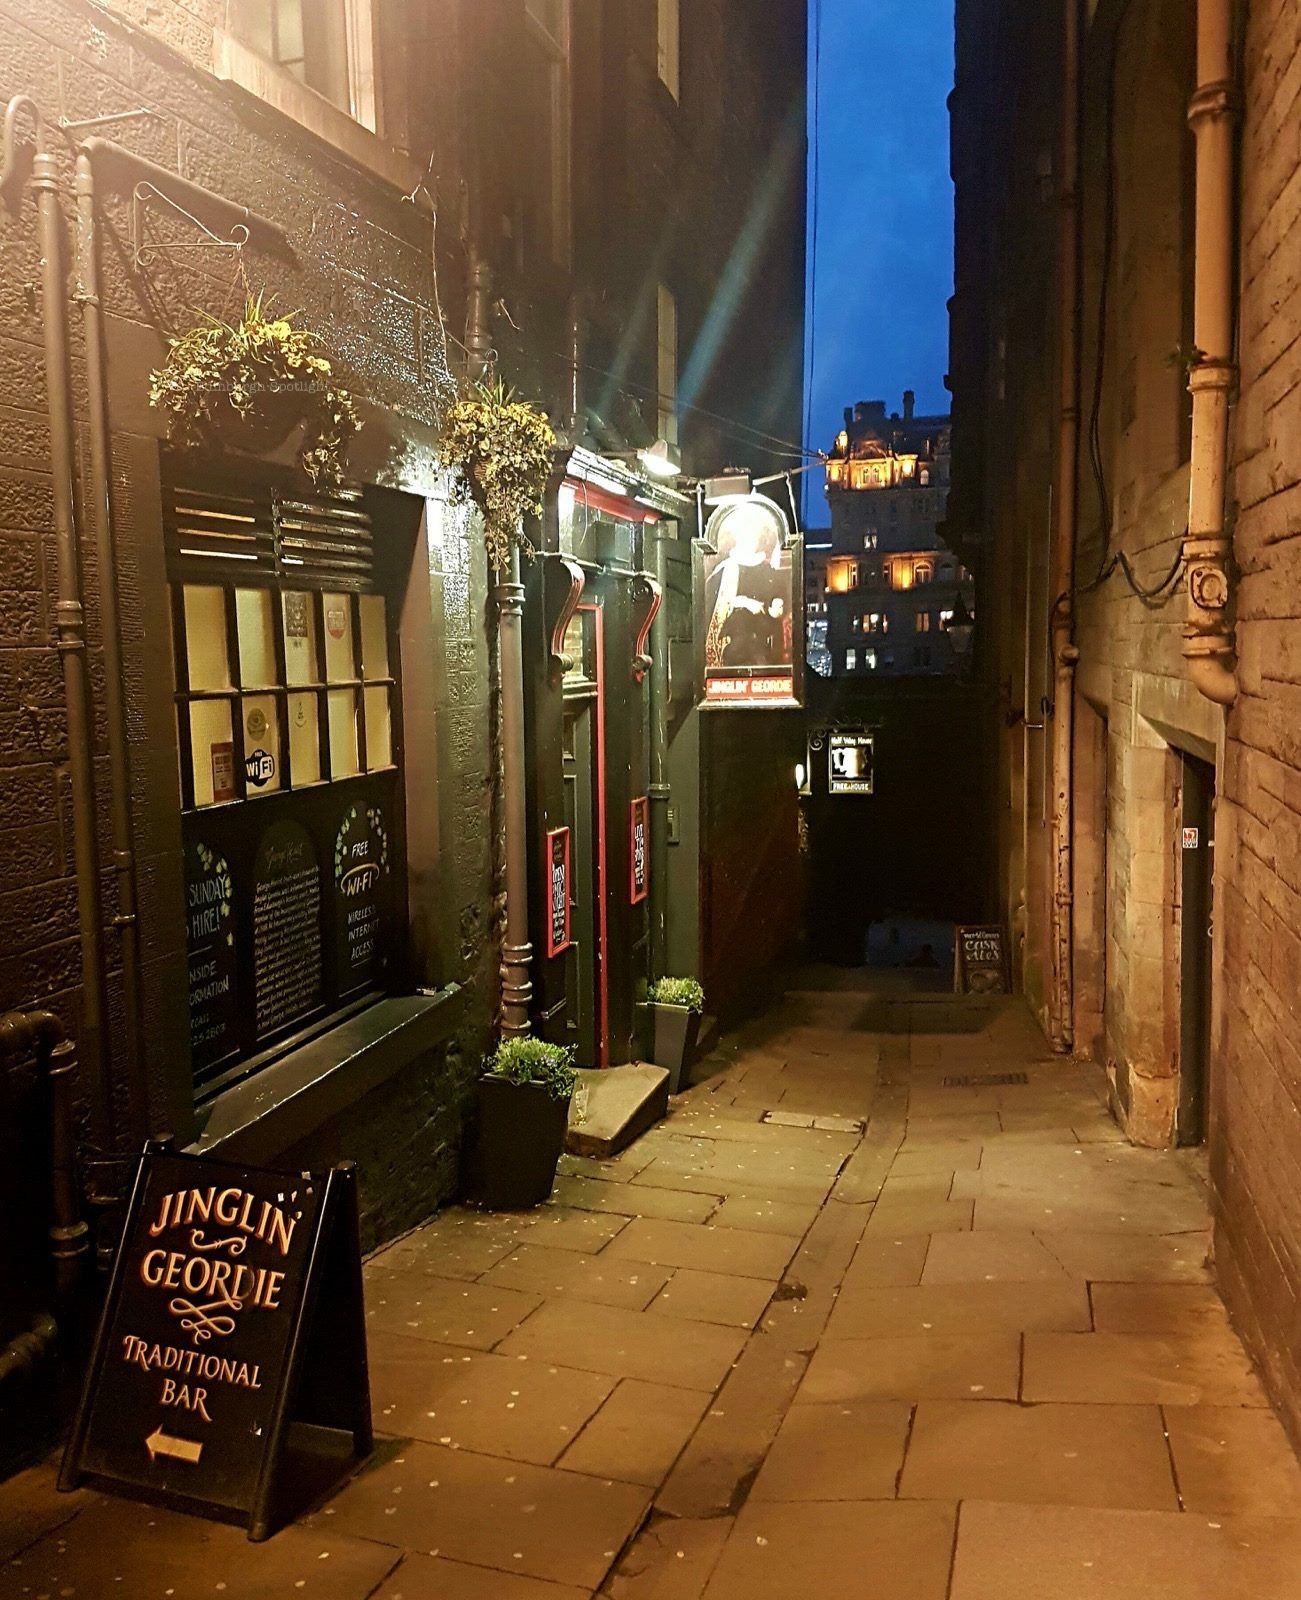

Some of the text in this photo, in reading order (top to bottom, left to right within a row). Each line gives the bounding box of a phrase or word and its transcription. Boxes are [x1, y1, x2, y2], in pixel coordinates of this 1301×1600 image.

[751, 679, 793, 693] GEORDIE
[351, 840, 369, 859] FREE
[189, 873, 227, 907] SUNDAY
[192, 905, 221, 939] HIRE!
[347, 904, 377, 925] WIRELESS
[348, 918, 380, 942] INTERNET
[351, 938, 375, 961] ACCESS
[143, 1249, 286, 1310] GEORDIE
[122, 1335, 263, 1390] TRADITIONAL
[161, 1379, 213, 1423] BAR
